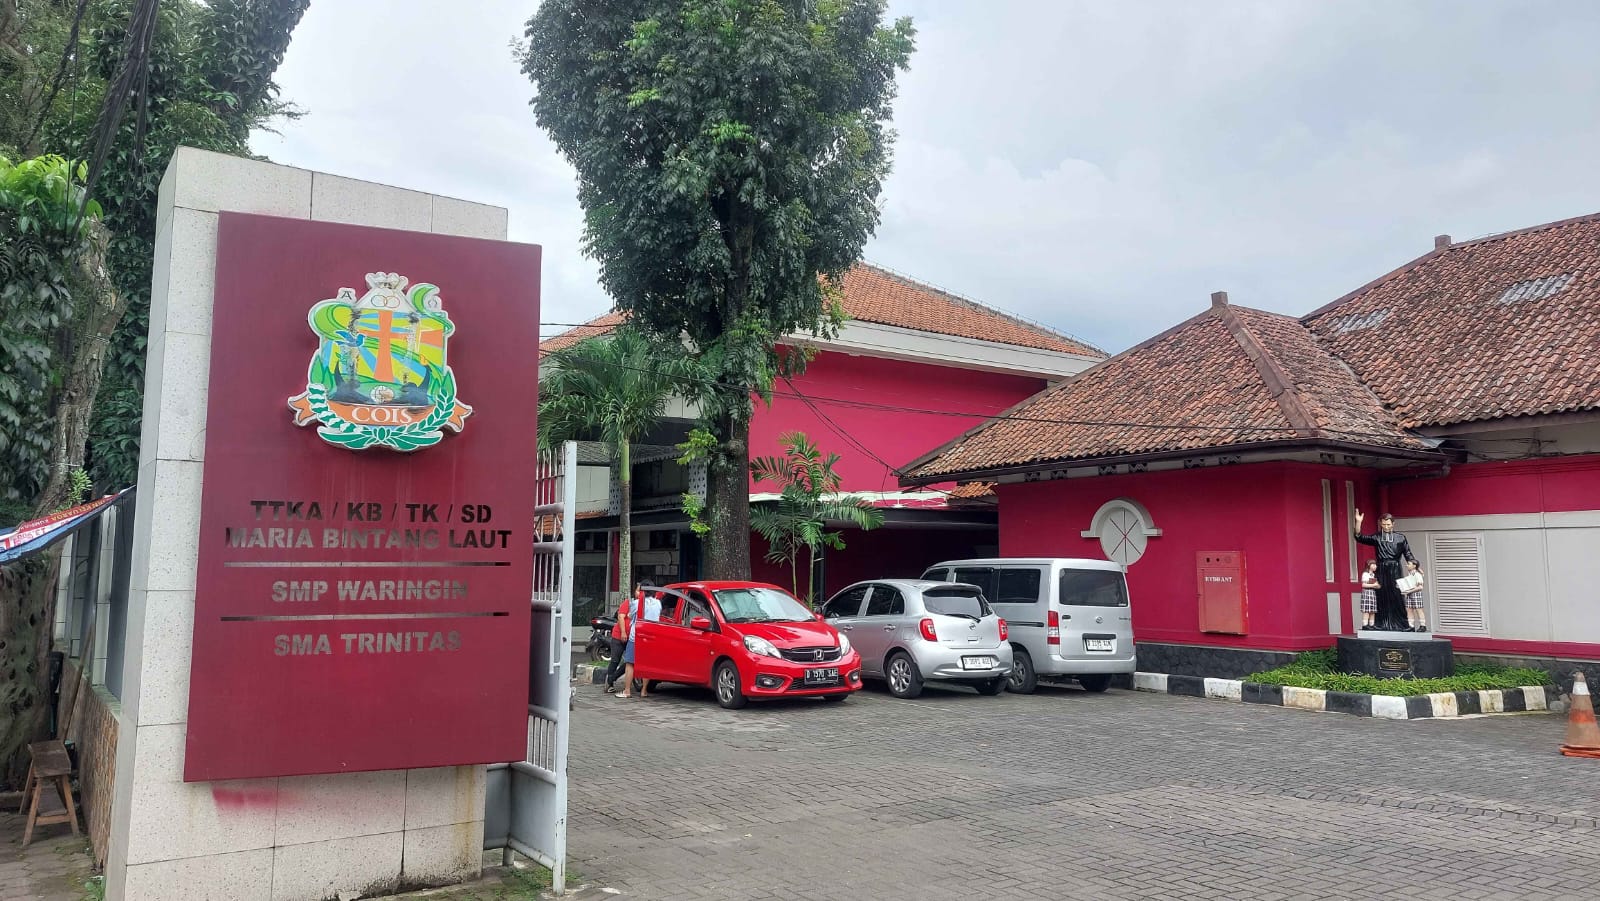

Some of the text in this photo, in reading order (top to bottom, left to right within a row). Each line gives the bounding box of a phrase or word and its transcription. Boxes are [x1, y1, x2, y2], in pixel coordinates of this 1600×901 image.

[351, 407, 413, 423] COIS
[251, 500, 323, 522] TTKA
[347, 502, 383, 522] KB
[405, 503, 439, 523] TK
[460, 504, 492, 523] SD
[225, 527, 512, 549] MARIA BINTANG LAUT
[271, 579, 468, 602] SMP WARINGIN
[274, 631, 462, 656] SMA TRINITAS
